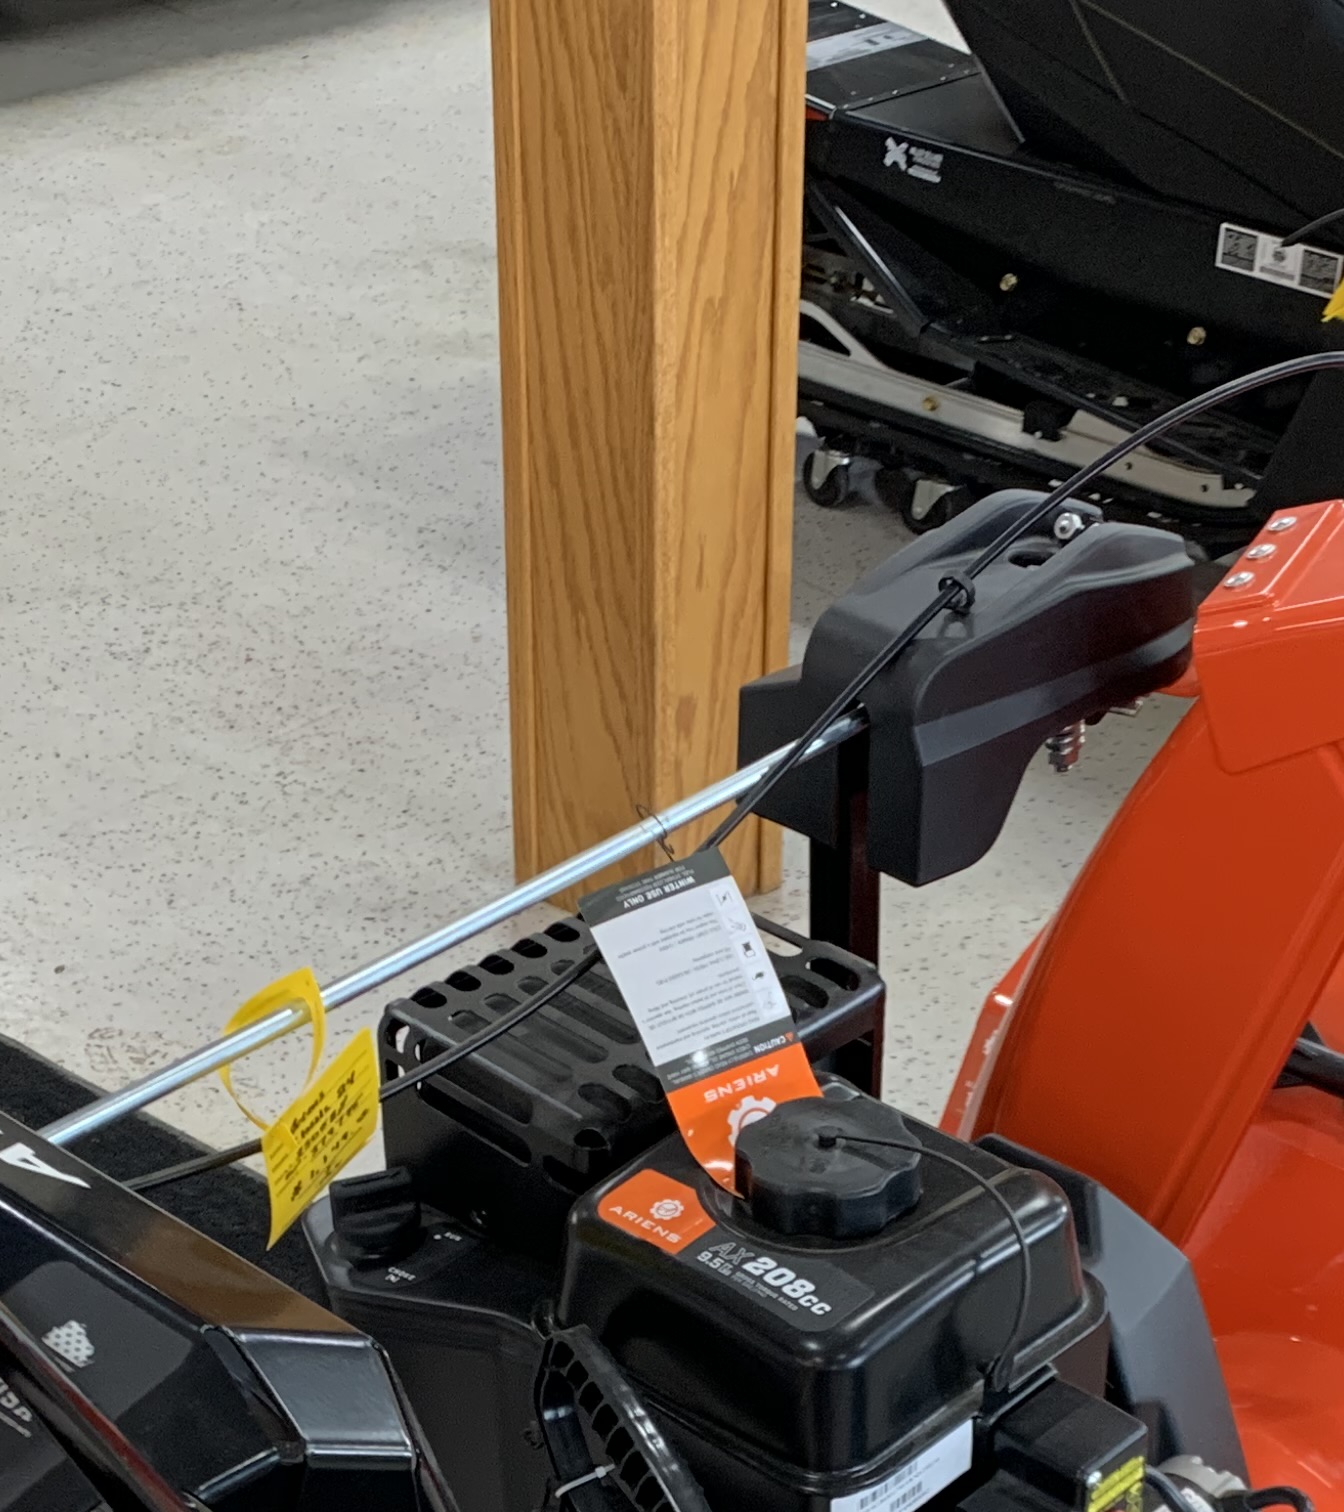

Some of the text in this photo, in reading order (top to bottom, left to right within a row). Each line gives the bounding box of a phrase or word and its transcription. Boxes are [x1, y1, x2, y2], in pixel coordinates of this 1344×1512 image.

[648, 883, 664, 898] USE
[662, 874, 696, 895] WINTER
[623, 893, 645, 911] ONLY
[753, 1036, 786, 1054] CAUTION
[703, 1063, 780, 1102] ARIENS
[609, 1205, 682, 1245] ARIENS
[709, 1241, 755, 1266] AX
[742, 1256, 832, 1316] 208cc
